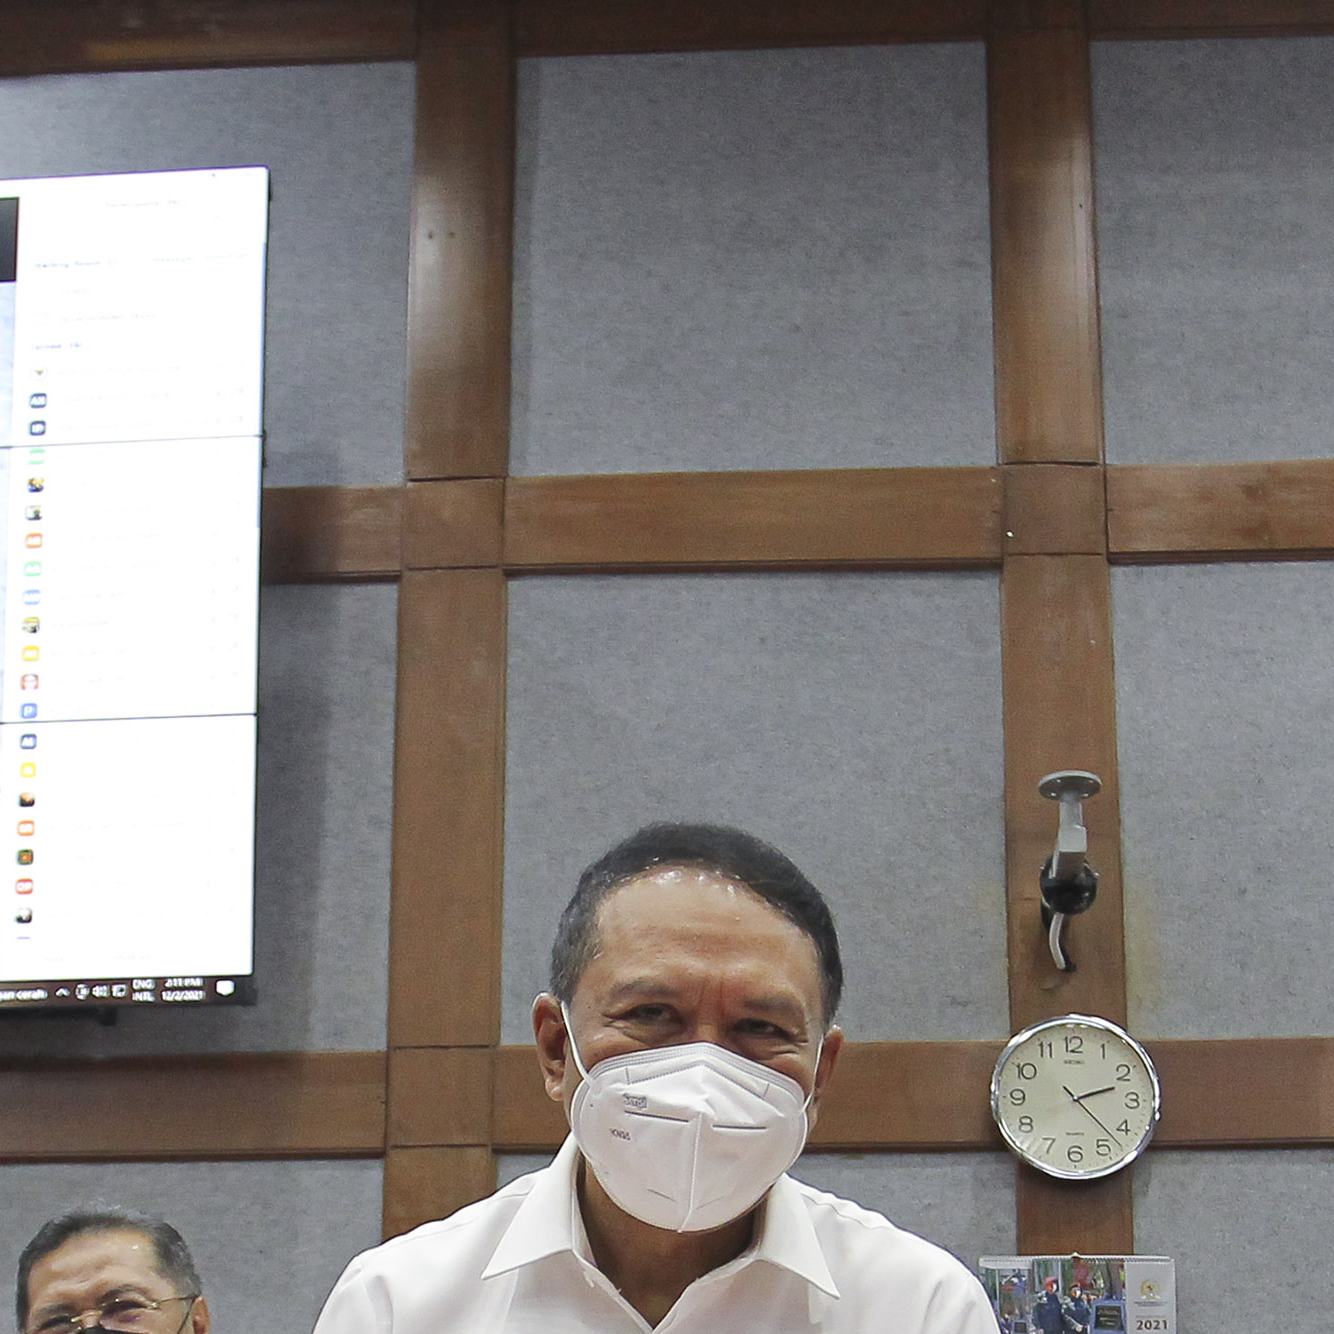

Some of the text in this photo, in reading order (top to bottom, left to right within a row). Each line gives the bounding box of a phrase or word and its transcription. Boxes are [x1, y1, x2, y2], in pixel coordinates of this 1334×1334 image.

[1038, 1041, 1053, 1059] 11
[1063, 1036, 1083, 1054] 12
[1100, 1043, 1106, 1059] 1
[1016, 1062, 1037, 1080] 10
[1116, 1064, 1131, 1082] 2
[1009, 1088, 1026, 1106] 9
[1124, 1091, 1140, 1109] 3
[1018, 1115, 1034, 1133] 8
[1116, 1119, 1131, 1136] 4
[1042, 1137, 1056, 1155] 7
[1067, 1145, 1083, 1163] 6
[1096, 1138, 1110, 1157] 5
[1136, 1319, 1168, 1331] 2021
